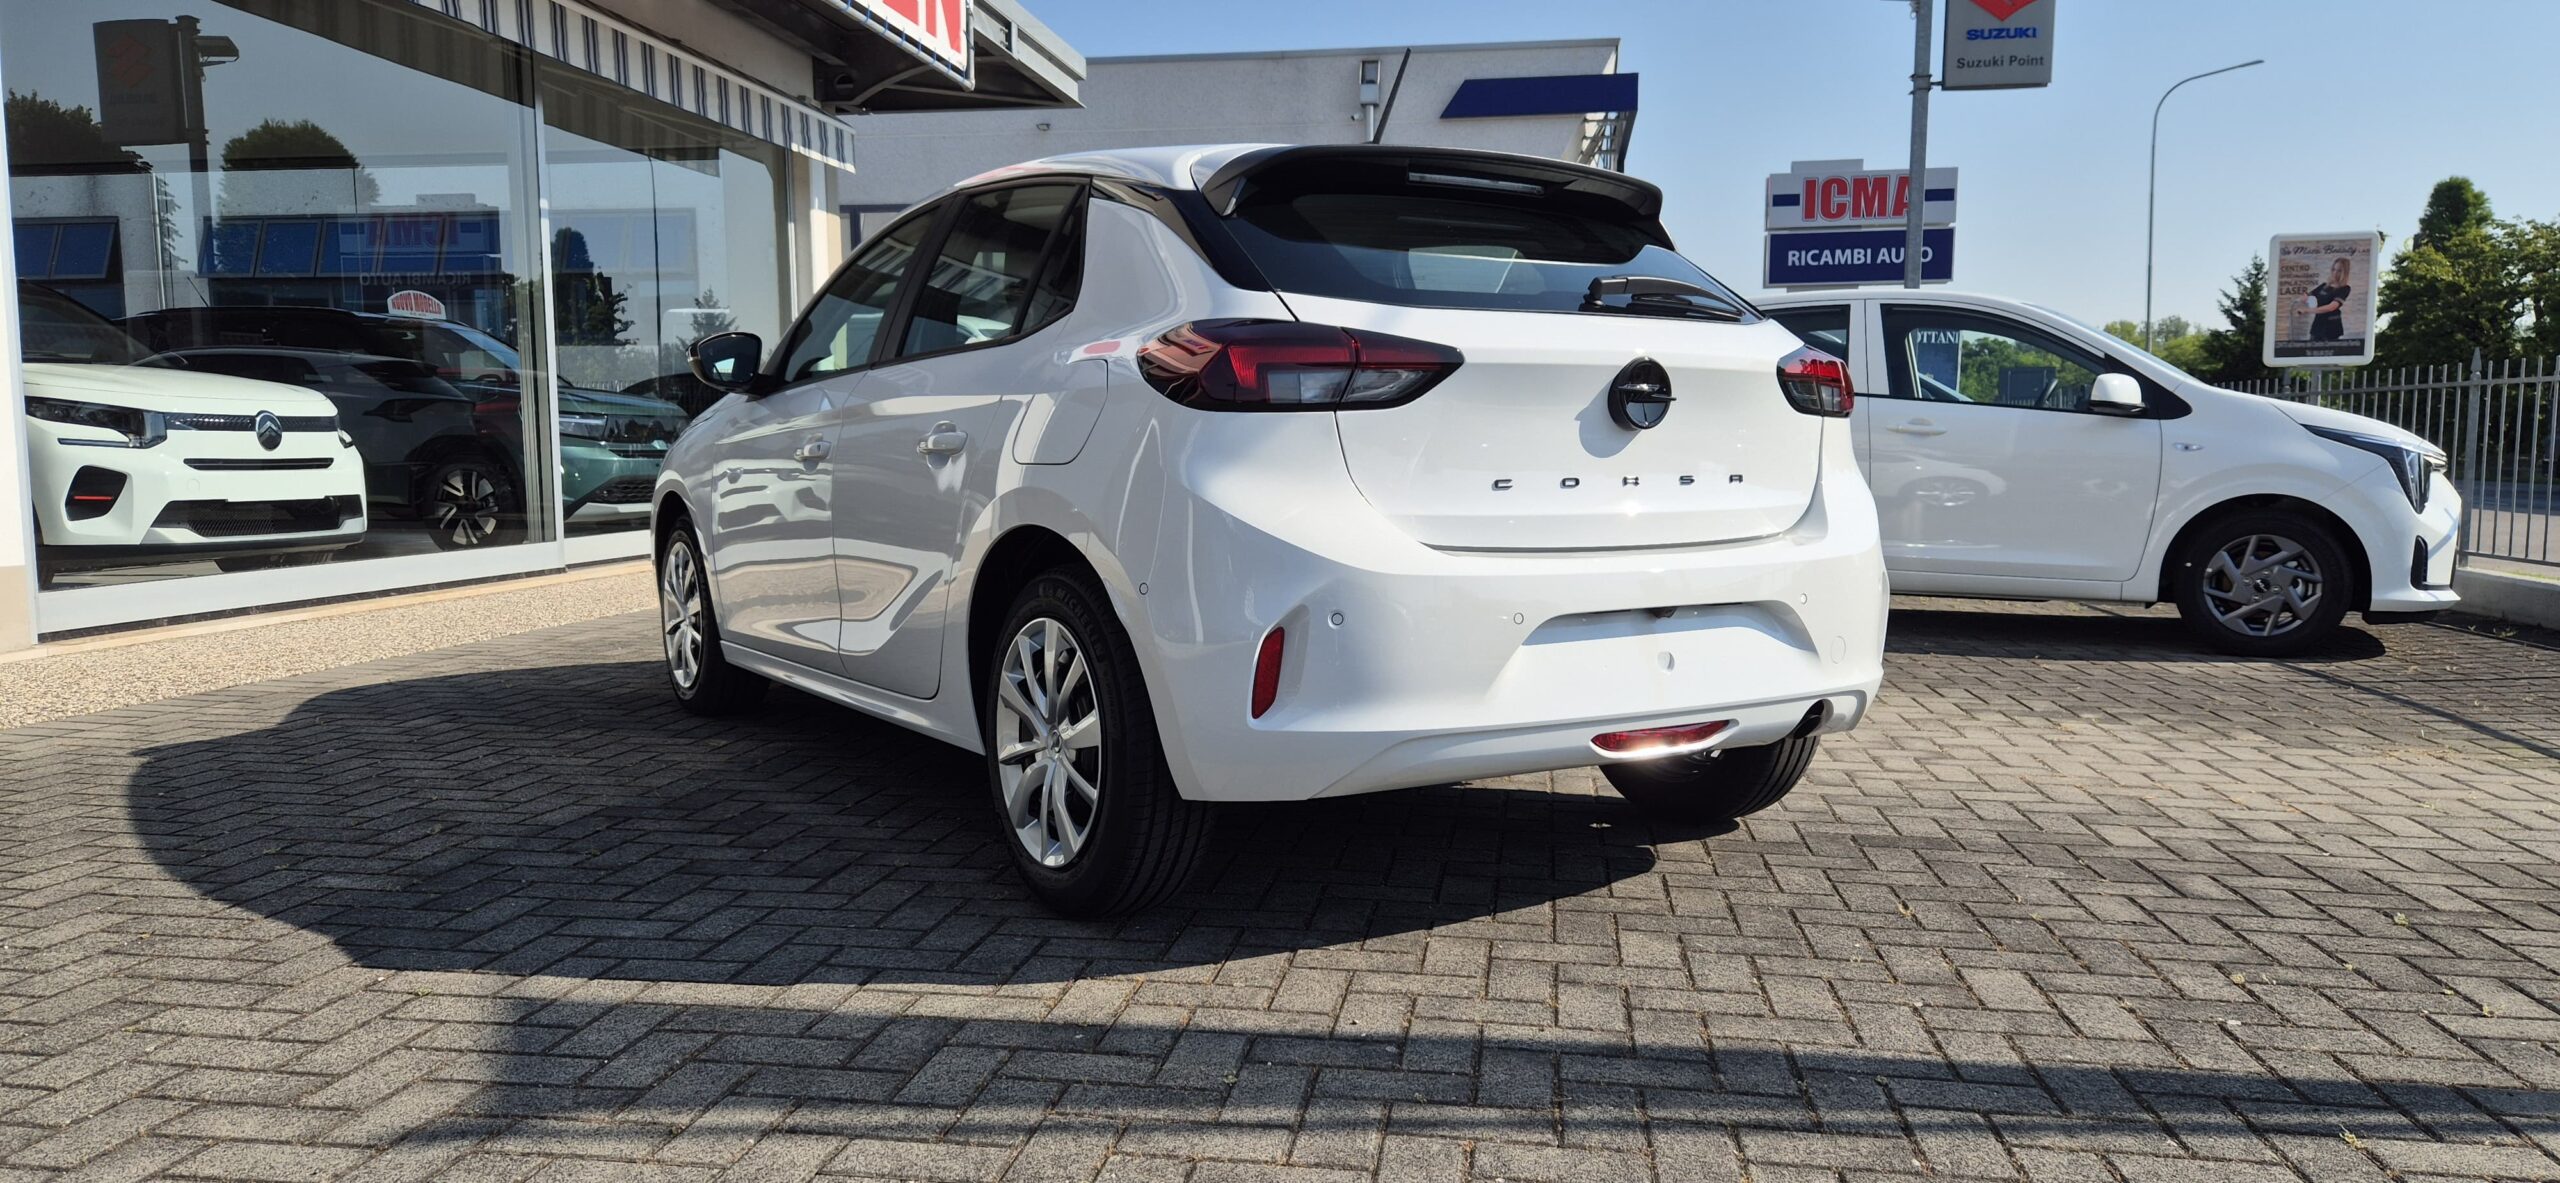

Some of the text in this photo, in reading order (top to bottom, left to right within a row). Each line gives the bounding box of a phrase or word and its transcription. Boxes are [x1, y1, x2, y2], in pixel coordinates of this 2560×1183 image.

[1967, 27, 2037, 41] SUZUKI
[1956, 55, 2045, 69] Suzuki Point
[1787, 246, 1934, 266] RICAMBI AUO
[2280, 287, 2309, 295] LASER
[392, 292, 442, 315] NUOVO MODELLO
[1492, 474, 1744, 491] CORSA
